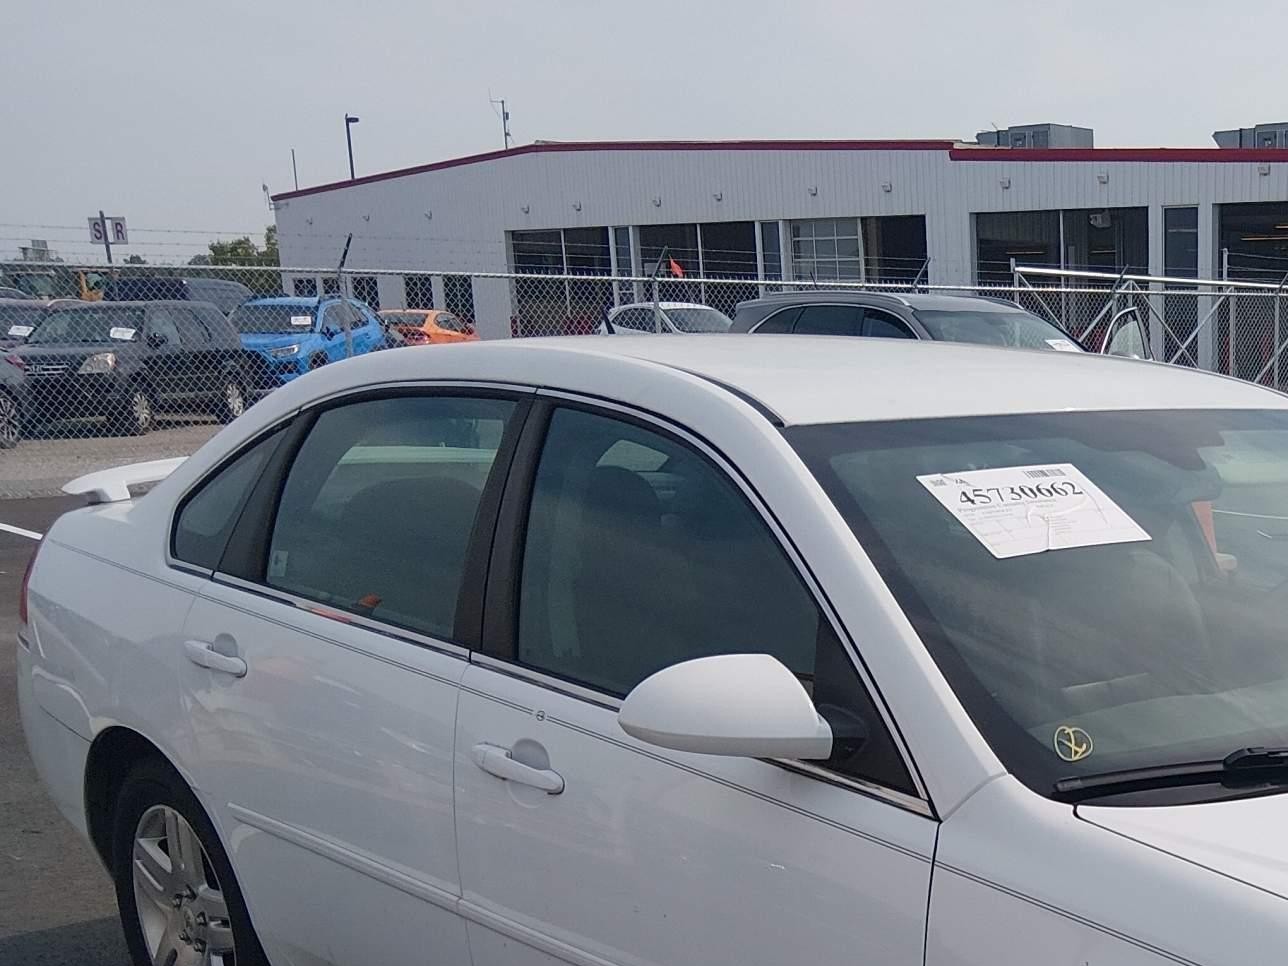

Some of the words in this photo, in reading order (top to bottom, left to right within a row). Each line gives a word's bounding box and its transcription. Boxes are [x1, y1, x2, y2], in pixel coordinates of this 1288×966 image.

[93, 222, 103, 240] S
[115, 222, 125, 240] R
[959, 481, 1084, 506] 45730662
